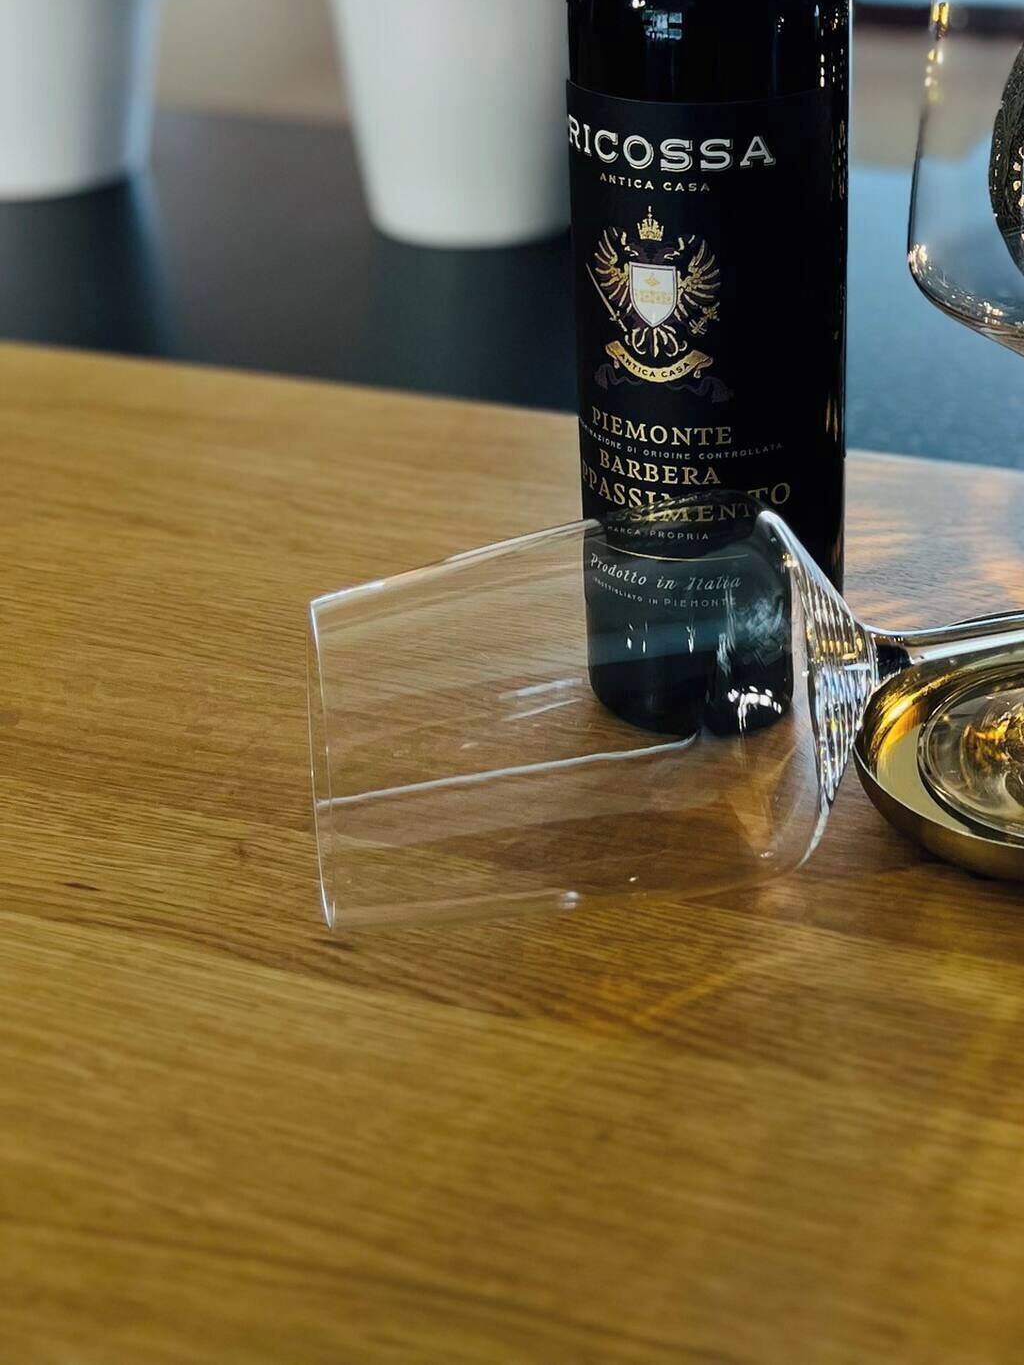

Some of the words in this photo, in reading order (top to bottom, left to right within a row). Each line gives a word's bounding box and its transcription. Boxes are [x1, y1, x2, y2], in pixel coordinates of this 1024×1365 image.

[568, 114, 776, 172] RICOSSA
[599, 172, 654, 190] ANTICA
[663, 181, 711, 193] CASA
[620, 353, 657, 378] ANTICA
[661, 362, 691, 378] CASA
[591, 405, 733, 446] PIEMONTE
[599, 448, 721, 485] BARBERA
[627, 445, 637, 454] DI
[643, 449, 691, 461] ORIGINE
[698, 442, 784, 461] CONTROLLATA
[607, 525, 641, 536] MARCA
[650, 529, 710, 541] PROPRIA
[590, 552, 648, 586] Prodotto
[656, 576, 676, 590] in
[683, 574, 742, 592] Italia
